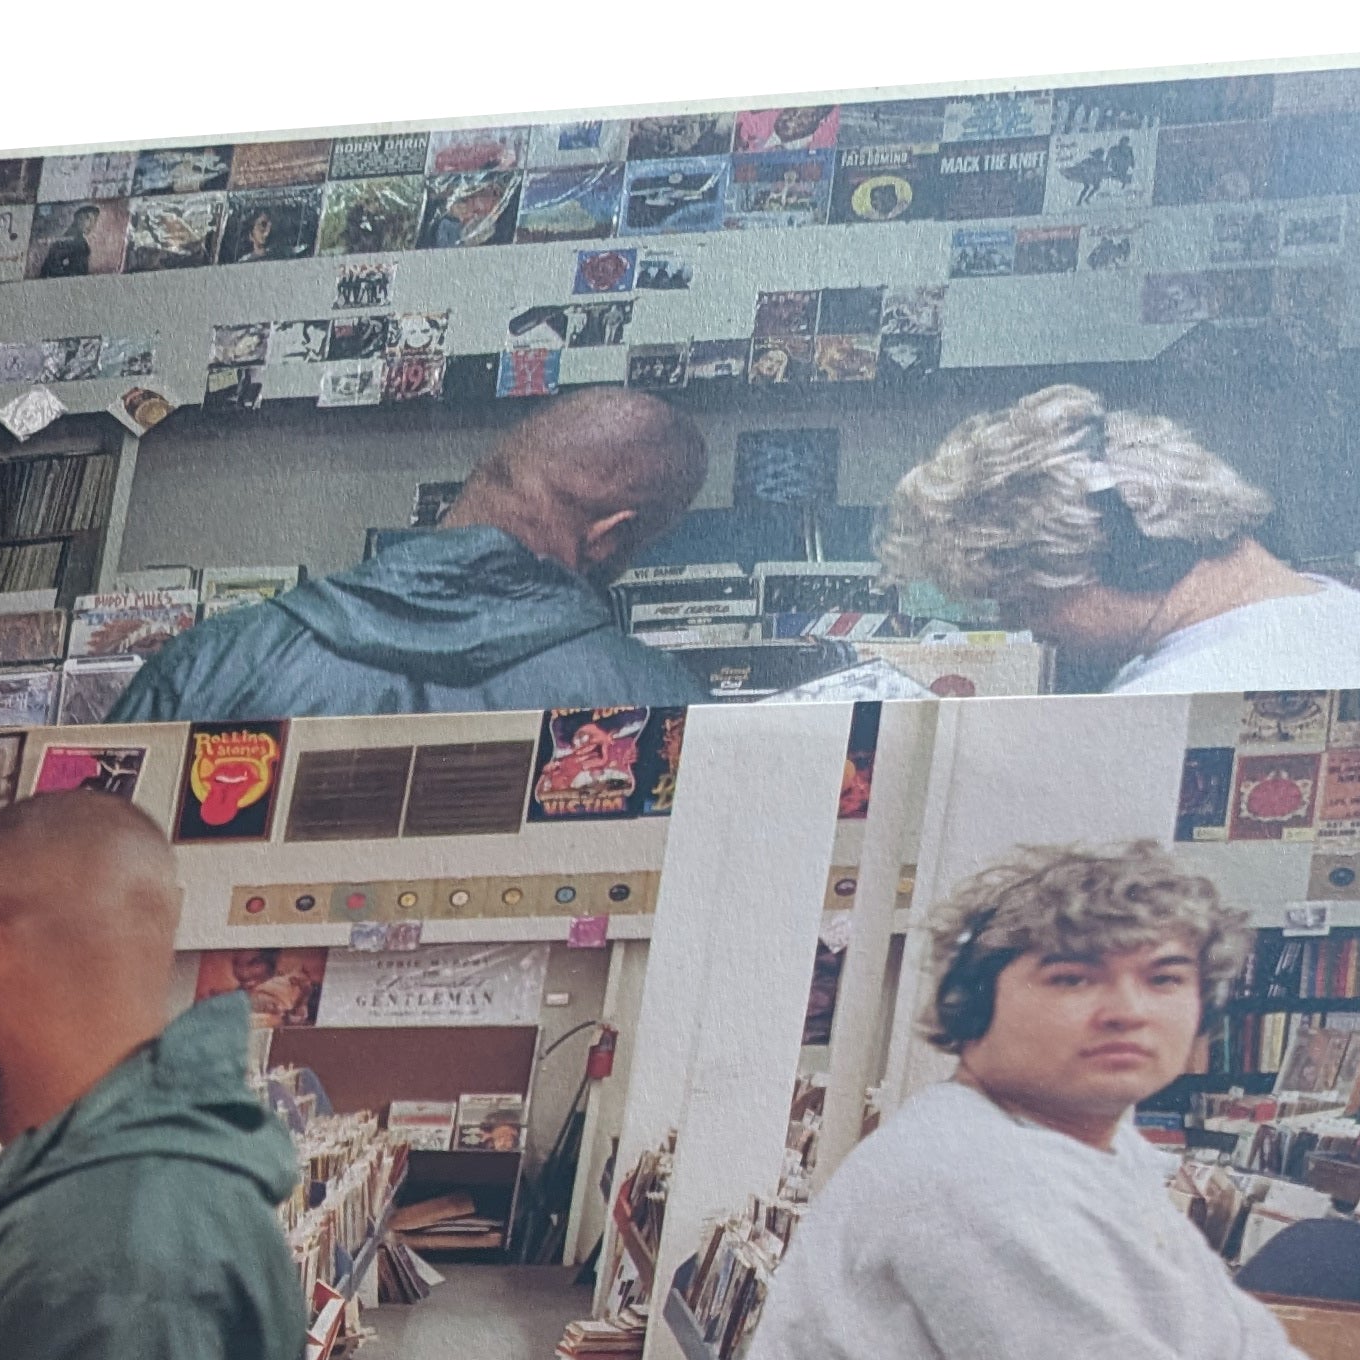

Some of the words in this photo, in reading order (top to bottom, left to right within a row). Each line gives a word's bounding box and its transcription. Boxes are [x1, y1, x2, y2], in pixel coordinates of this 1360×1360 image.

[841, 151, 865, 167] FATS
[941, 155, 980, 174] MACK
[984, 153, 1007, 171] THE
[543, 797, 623, 815] VICTIM
[355, 990, 493, 1007] GENTLEMAN
